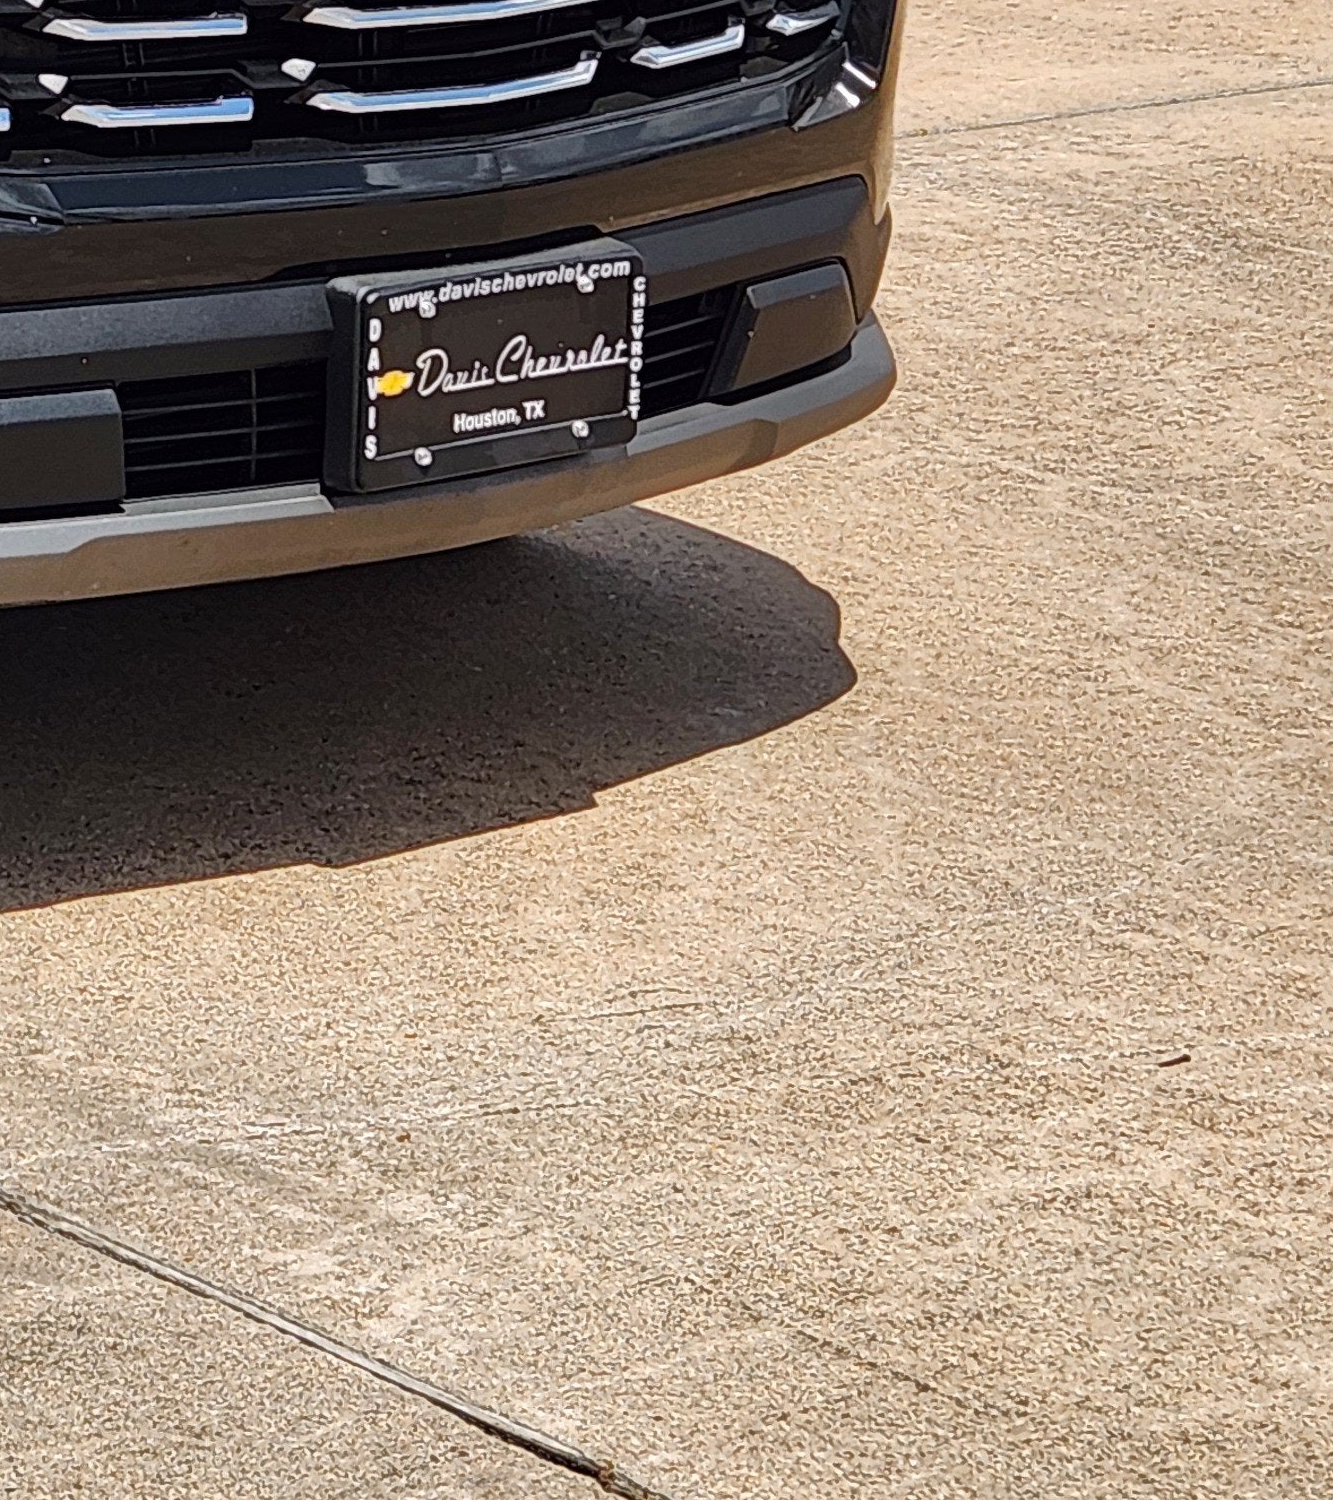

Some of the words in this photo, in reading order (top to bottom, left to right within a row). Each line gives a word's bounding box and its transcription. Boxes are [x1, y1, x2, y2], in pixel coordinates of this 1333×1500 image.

[389, 260, 631, 314] www.davischevrolet.com
[416, 348, 496, 397] Davis
[495, 334, 630, 384] Chevrolet
[630, 276, 647, 420] CHEVROLET
[364, 318, 382, 460] DAVIS
[453, 407, 522, 434] Houston,
[522, 400, 546, 421] TX
